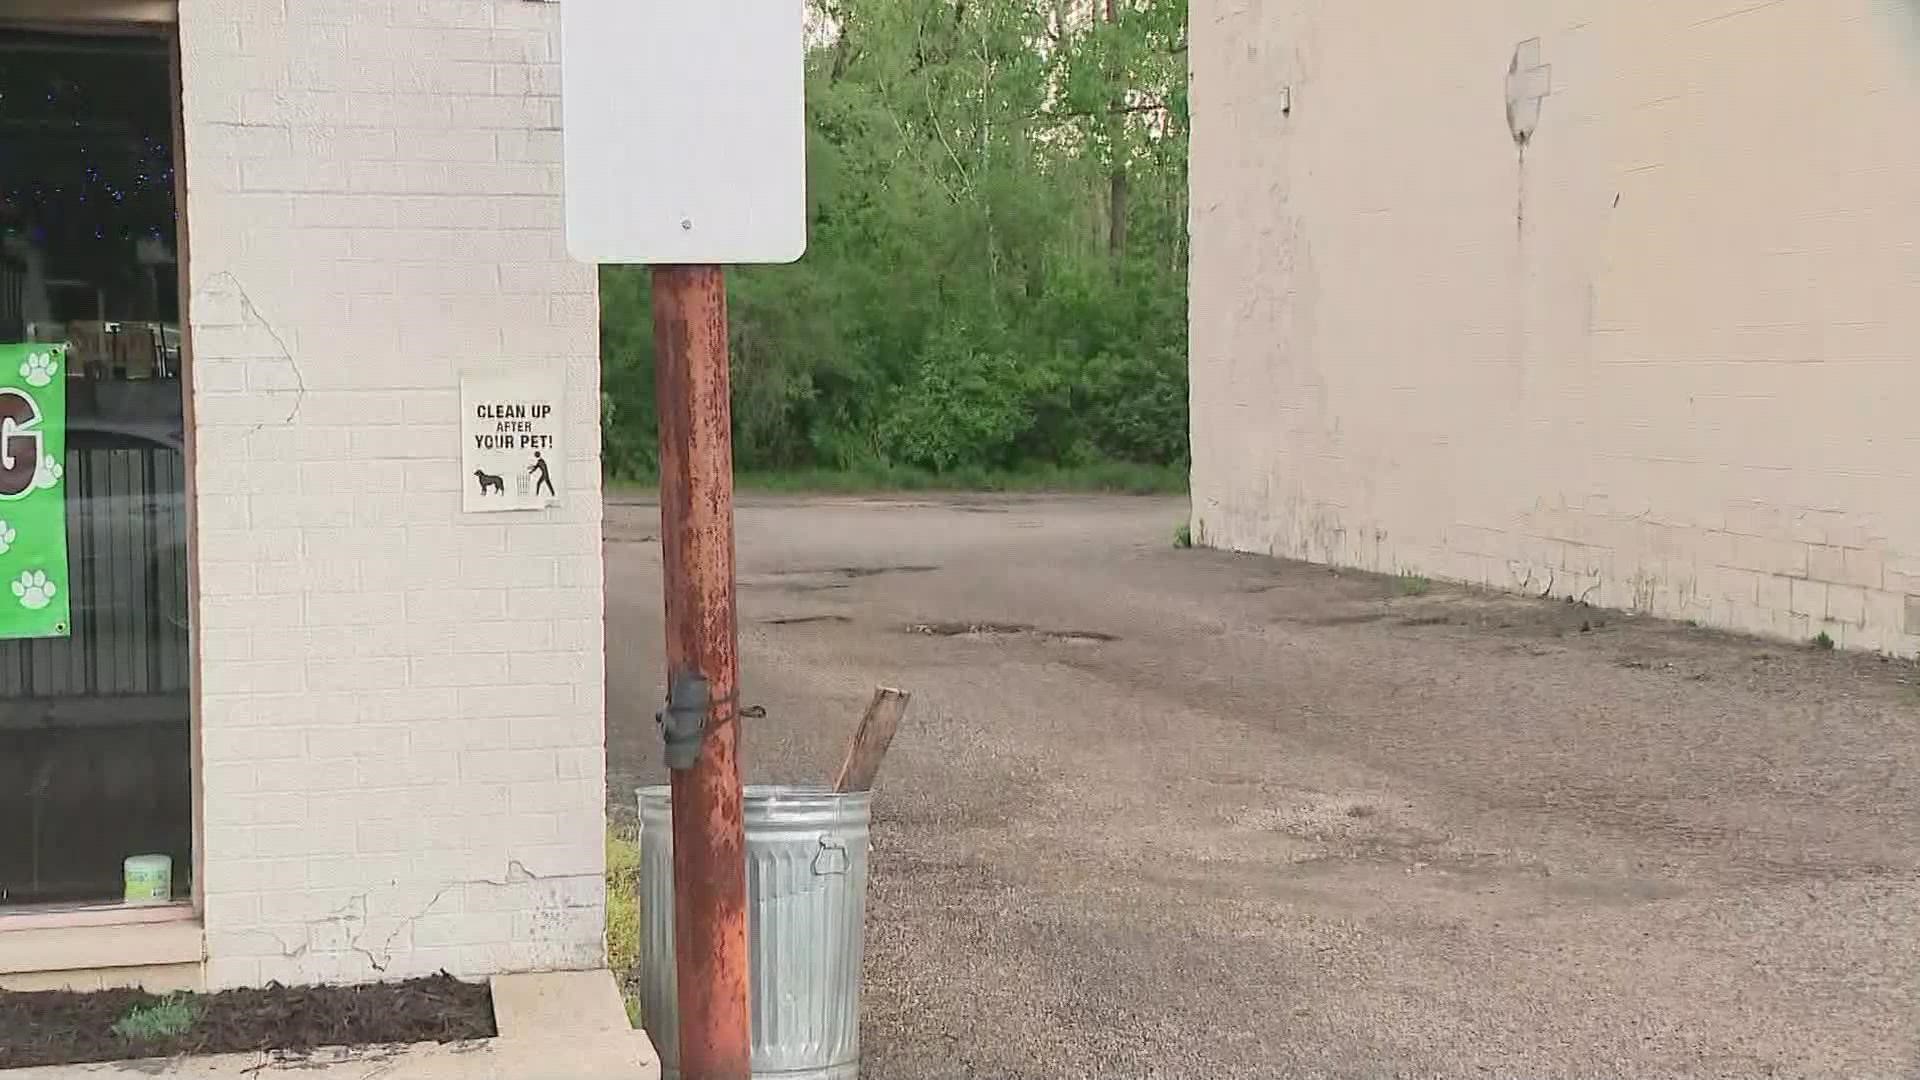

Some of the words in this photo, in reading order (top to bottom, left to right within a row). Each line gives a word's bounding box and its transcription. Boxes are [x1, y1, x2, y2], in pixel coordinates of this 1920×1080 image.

[477, 404, 526, 418] CLEAN
[531, 404, 551, 418] UP
[496, 421, 532, 432] AFTER
[475, 435, 514, 449] YOUR
[520, 435, 553, 449] PET!
